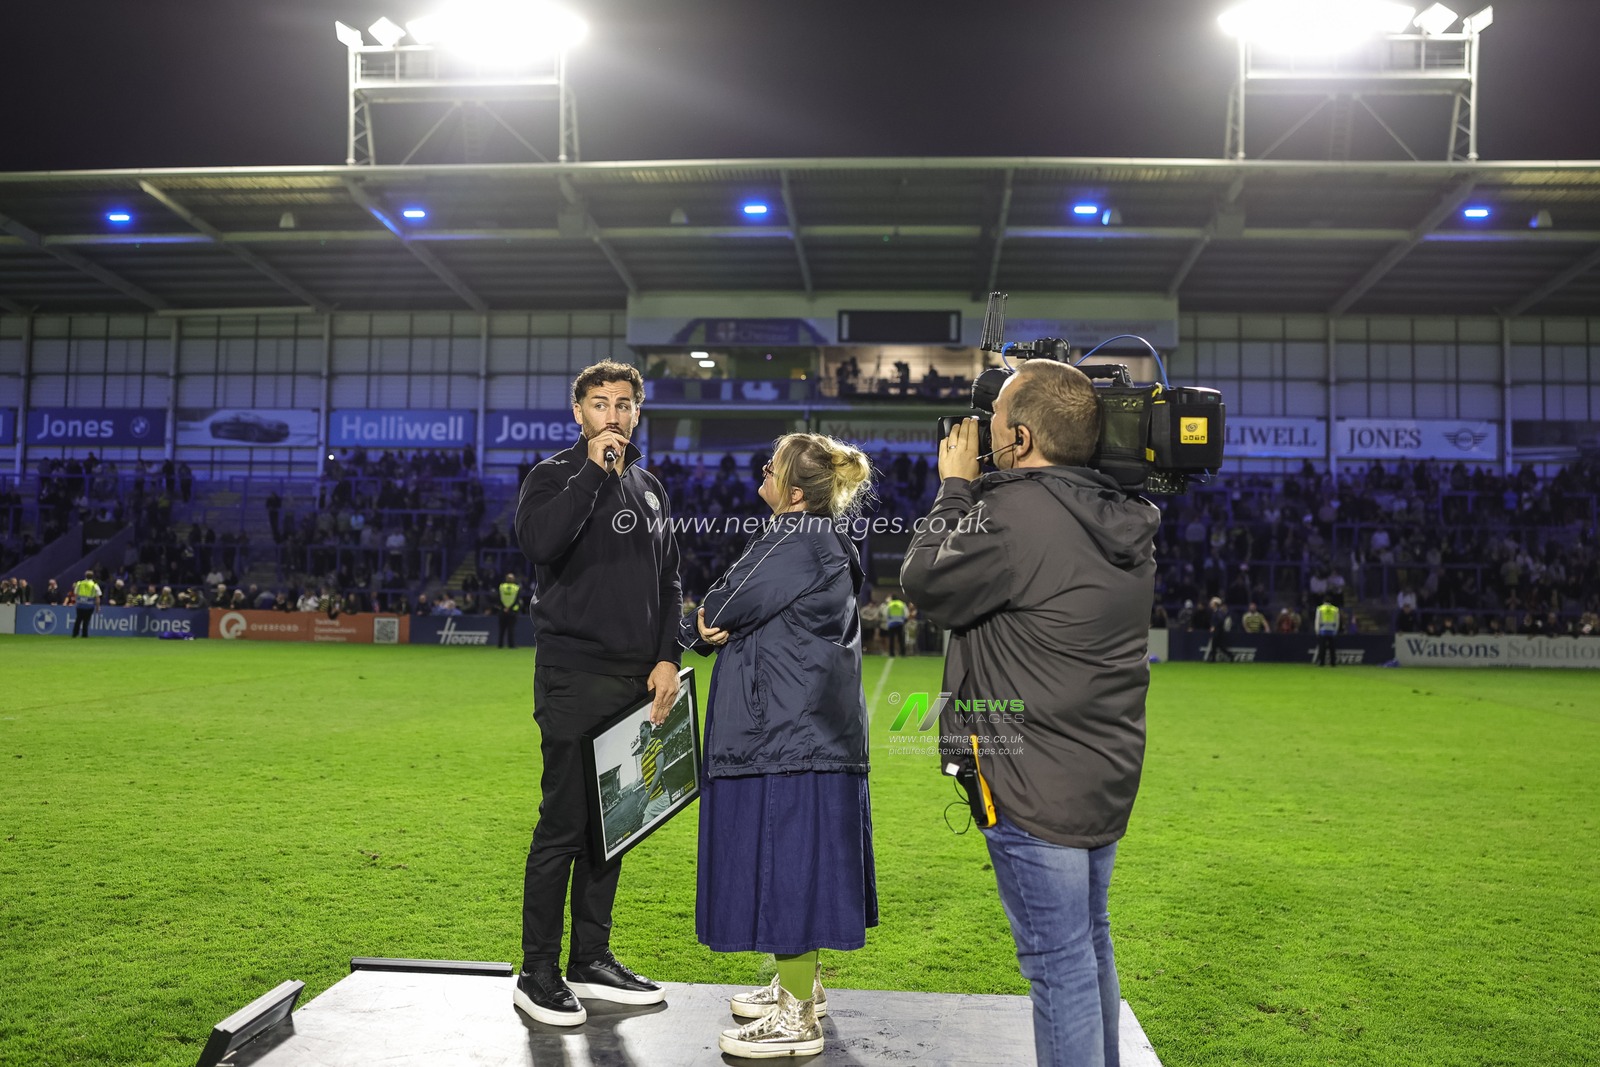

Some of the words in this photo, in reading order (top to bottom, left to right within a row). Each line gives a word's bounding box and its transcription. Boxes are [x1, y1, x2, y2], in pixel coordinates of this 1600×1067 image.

[37, 414, 114, 440] Jones
[341, 415, 464, 441] Halliwell
[496, 415, 580, 443] Jones
[1348, 426, 1421, 454] JONES
[66, 612, 138, 632] Hlliwell
[142, 615, 191, 633] Jones
[1406, 638, 1500, 659] Watsons
